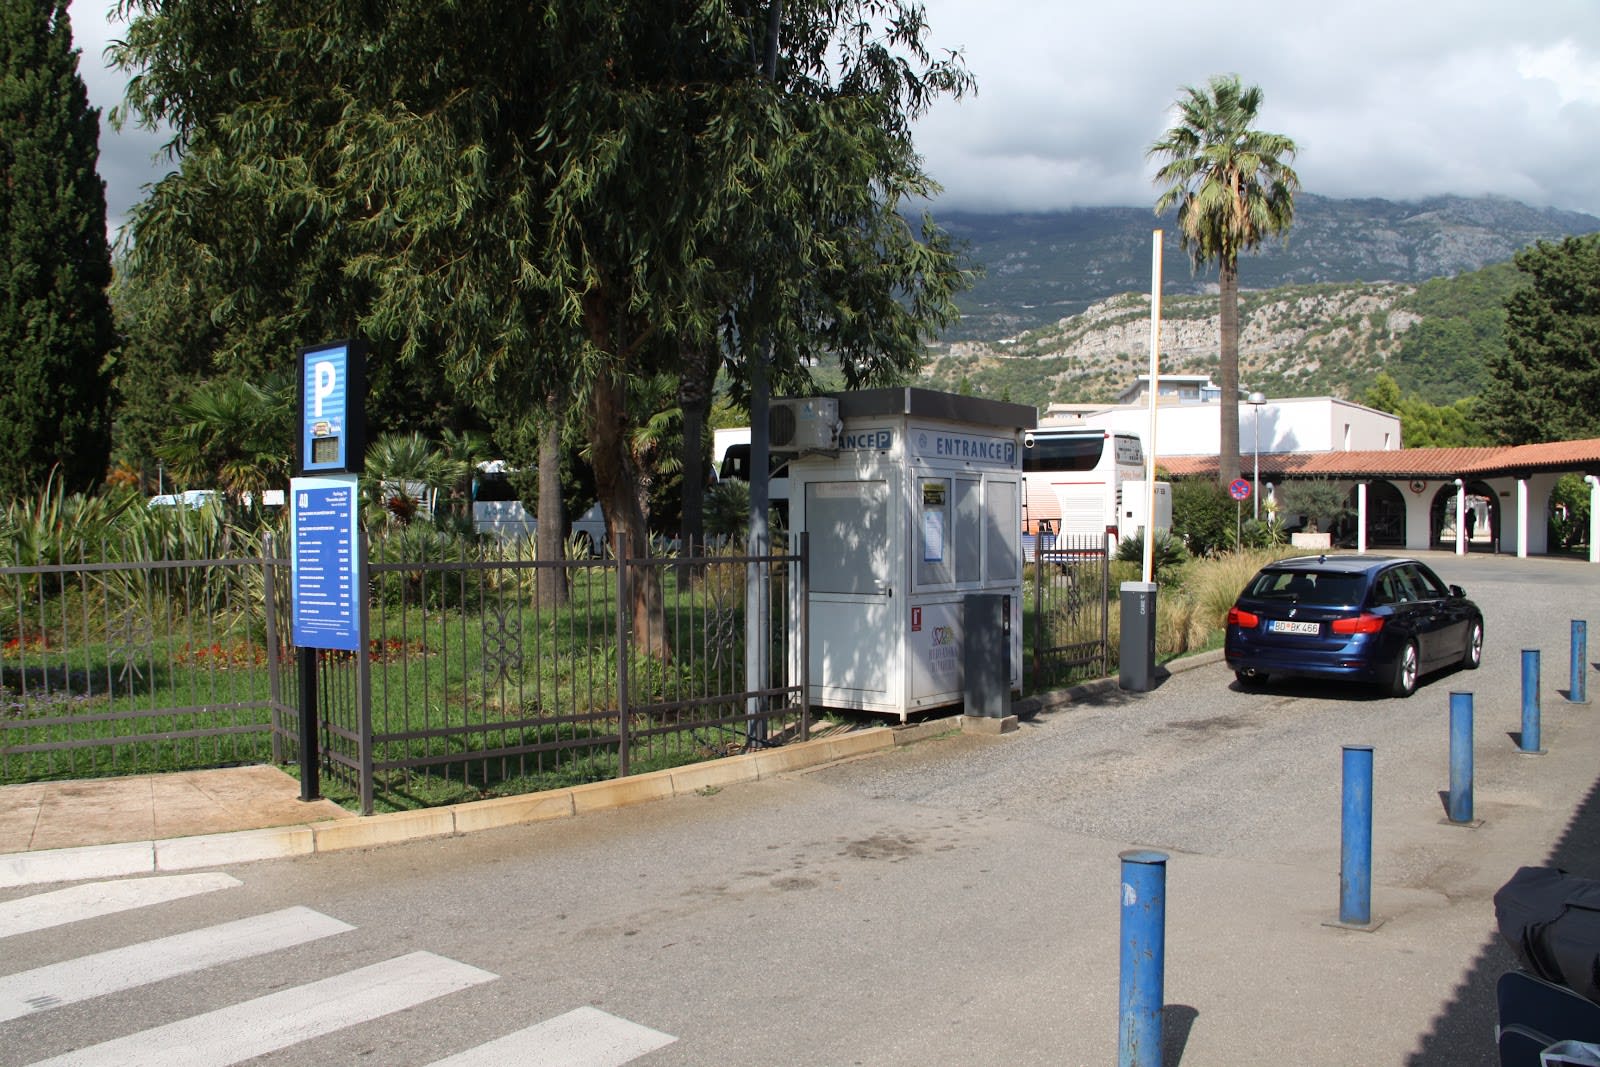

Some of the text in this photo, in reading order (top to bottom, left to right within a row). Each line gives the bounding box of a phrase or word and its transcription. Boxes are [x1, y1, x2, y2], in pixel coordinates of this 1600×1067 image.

[315, 361, 336, 417] P
[937, 437, 1001, 460] ENTRANCE
[1302, 623, 1318, 633] 466
